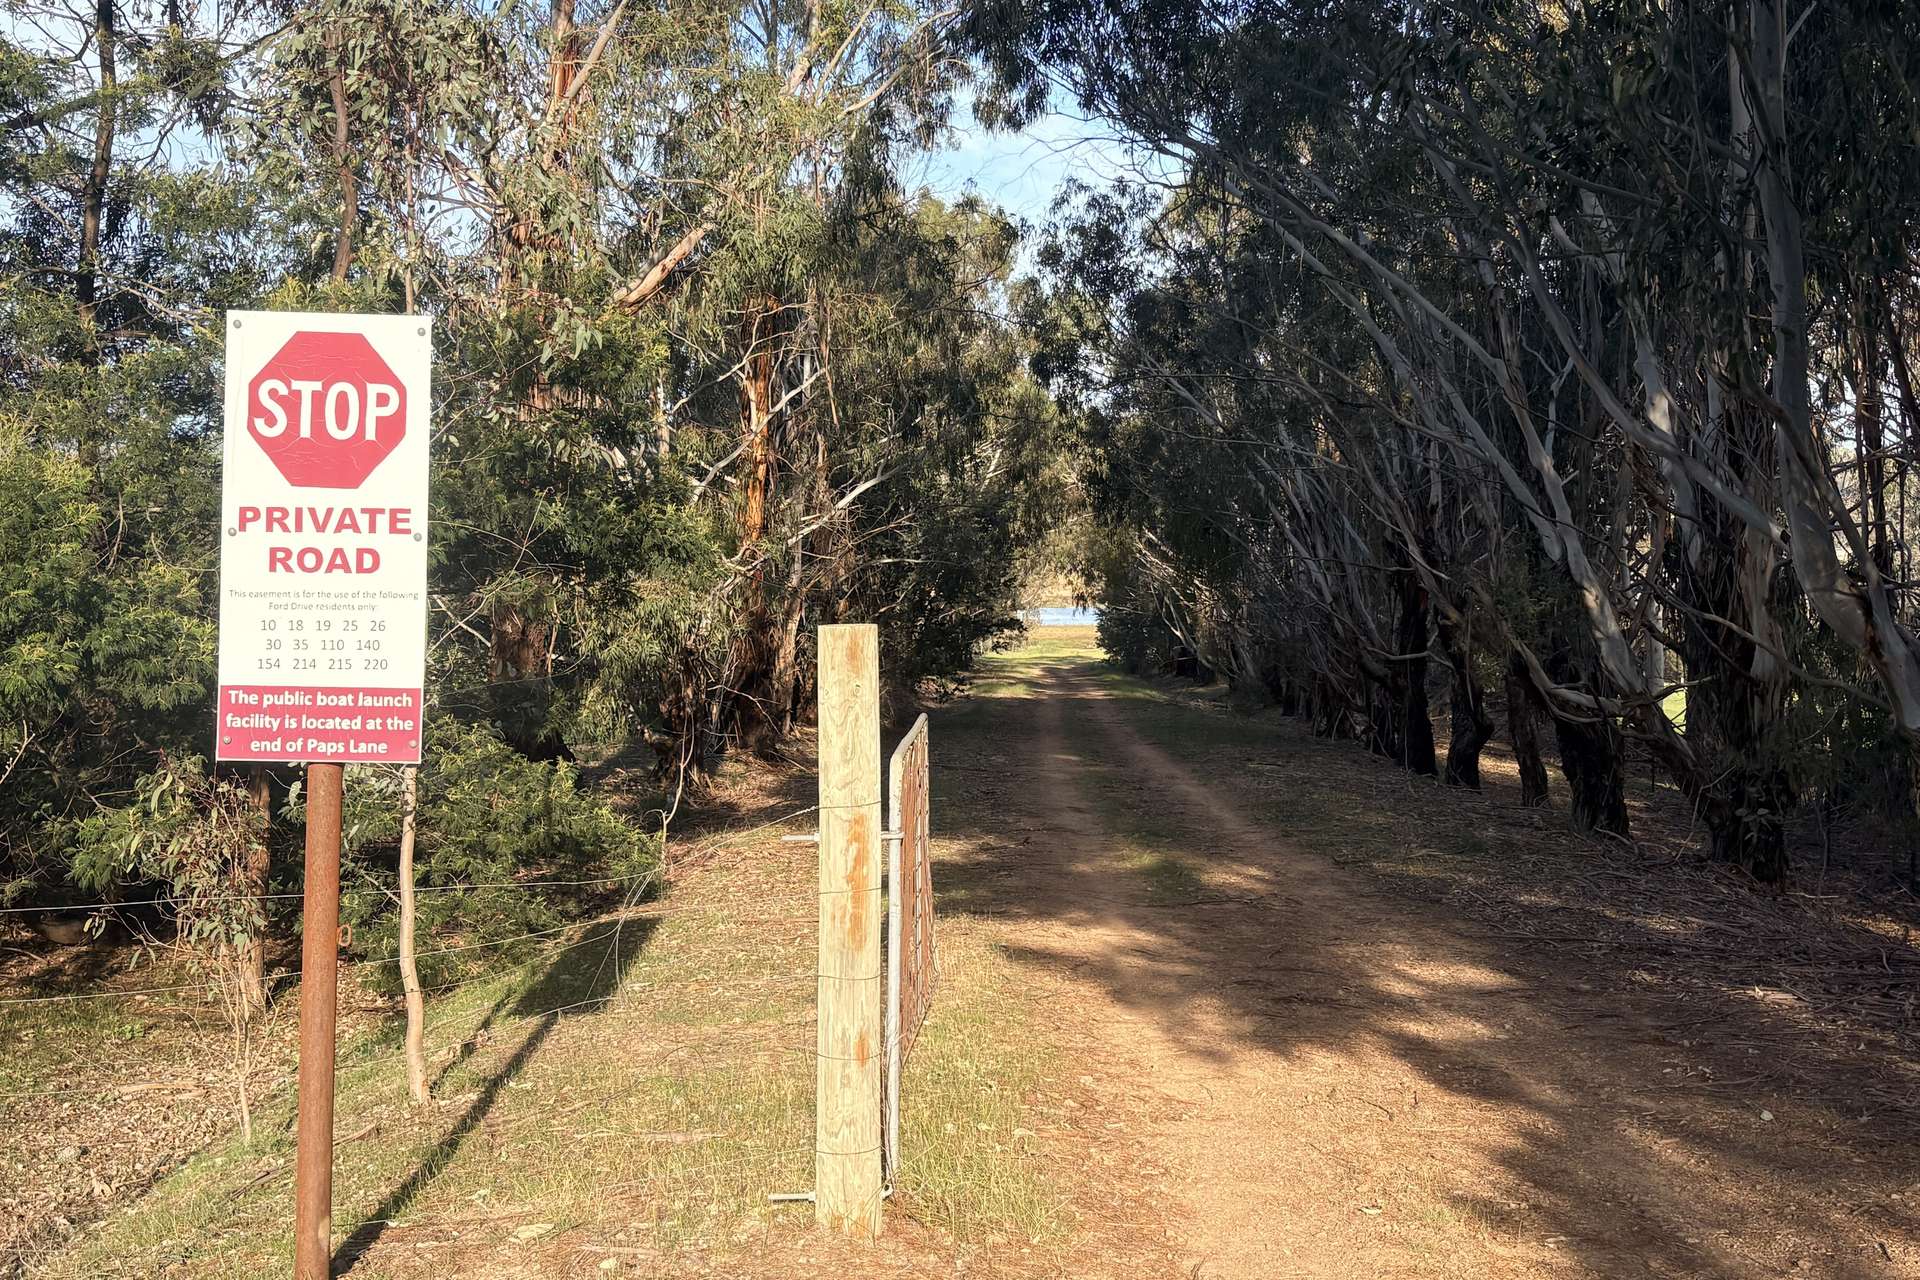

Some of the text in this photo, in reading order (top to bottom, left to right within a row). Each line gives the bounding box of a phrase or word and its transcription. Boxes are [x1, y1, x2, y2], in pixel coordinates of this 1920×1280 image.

[253, 378, 400, 441] STOP
[238, 506, 412, 535] PRIVATE
[268, 546, 381, 574] ROAD
[229, 589, 247, 598] This
[248, 590, 291, 599] easement
[293, 591, 301, 599] is
[302, 590, 315, 599] for
[317, 590, 332, 599] the
[351, 590, 361, 599] of
[362, 591, 377, 599] the
[379, 591, 419, 600] following
[268, 602, 289, 610] Ford
[290, 602, 314, 611] Drive
[316, 603, 355, 611] residents
[260, 619, 386, 632] 10 18 19 25 26
[265, 638, 381, 651] 30 35 110 140
[257, 658, 388, 671] 154 214 215 220
[227, 689, 413, 709] The public boat launch
[225, 713, 415, 732] facility is located at the
[250, 737, 389, 757] end of Paps Lane
